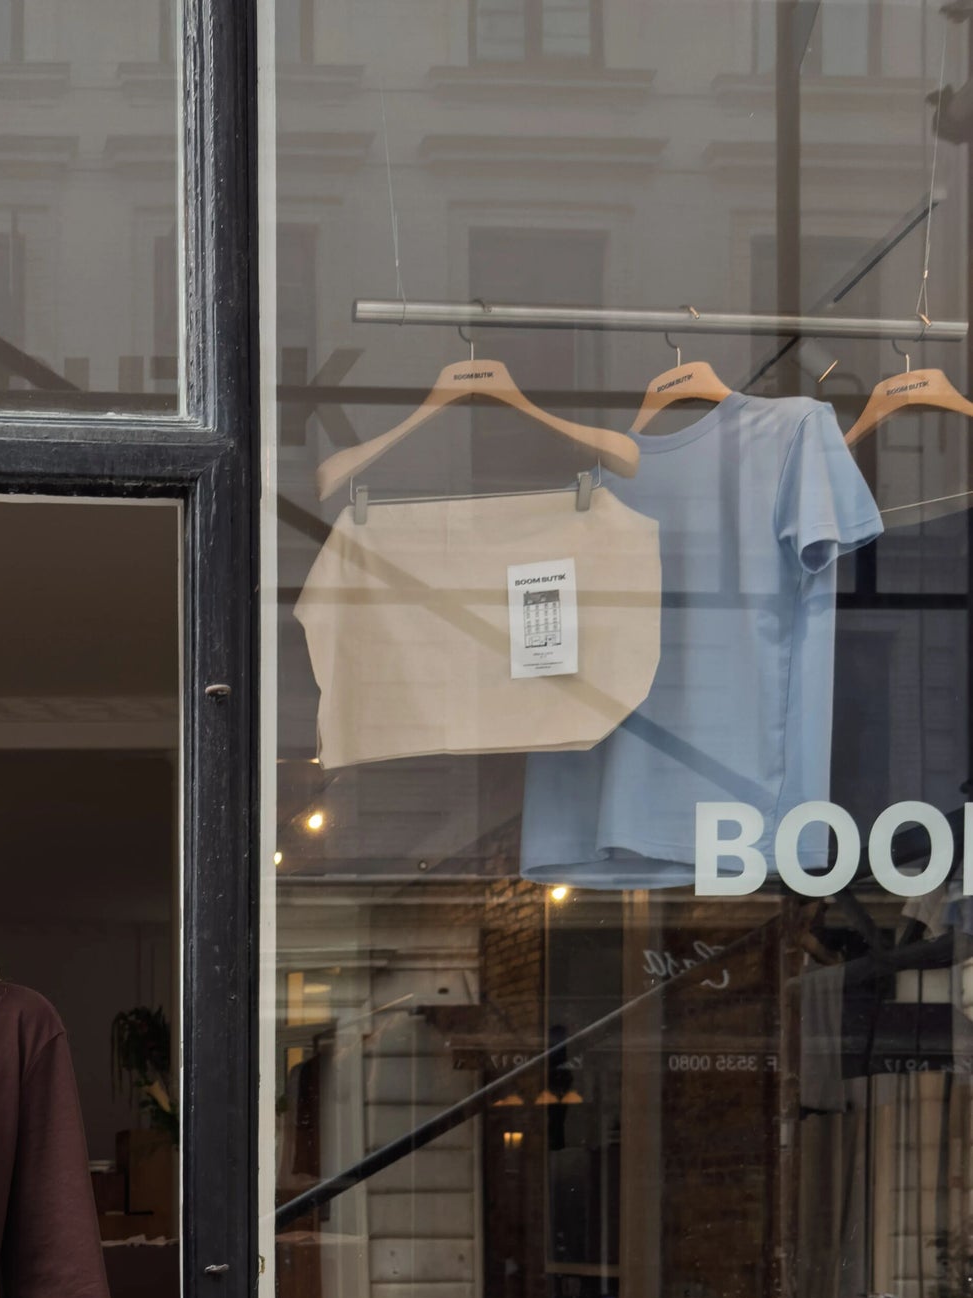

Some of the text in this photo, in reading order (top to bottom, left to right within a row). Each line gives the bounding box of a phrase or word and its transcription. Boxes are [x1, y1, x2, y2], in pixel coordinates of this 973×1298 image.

[514, 572, 567, 587] BOOM BUTIK
[694, 800, 973, 897] BOO
